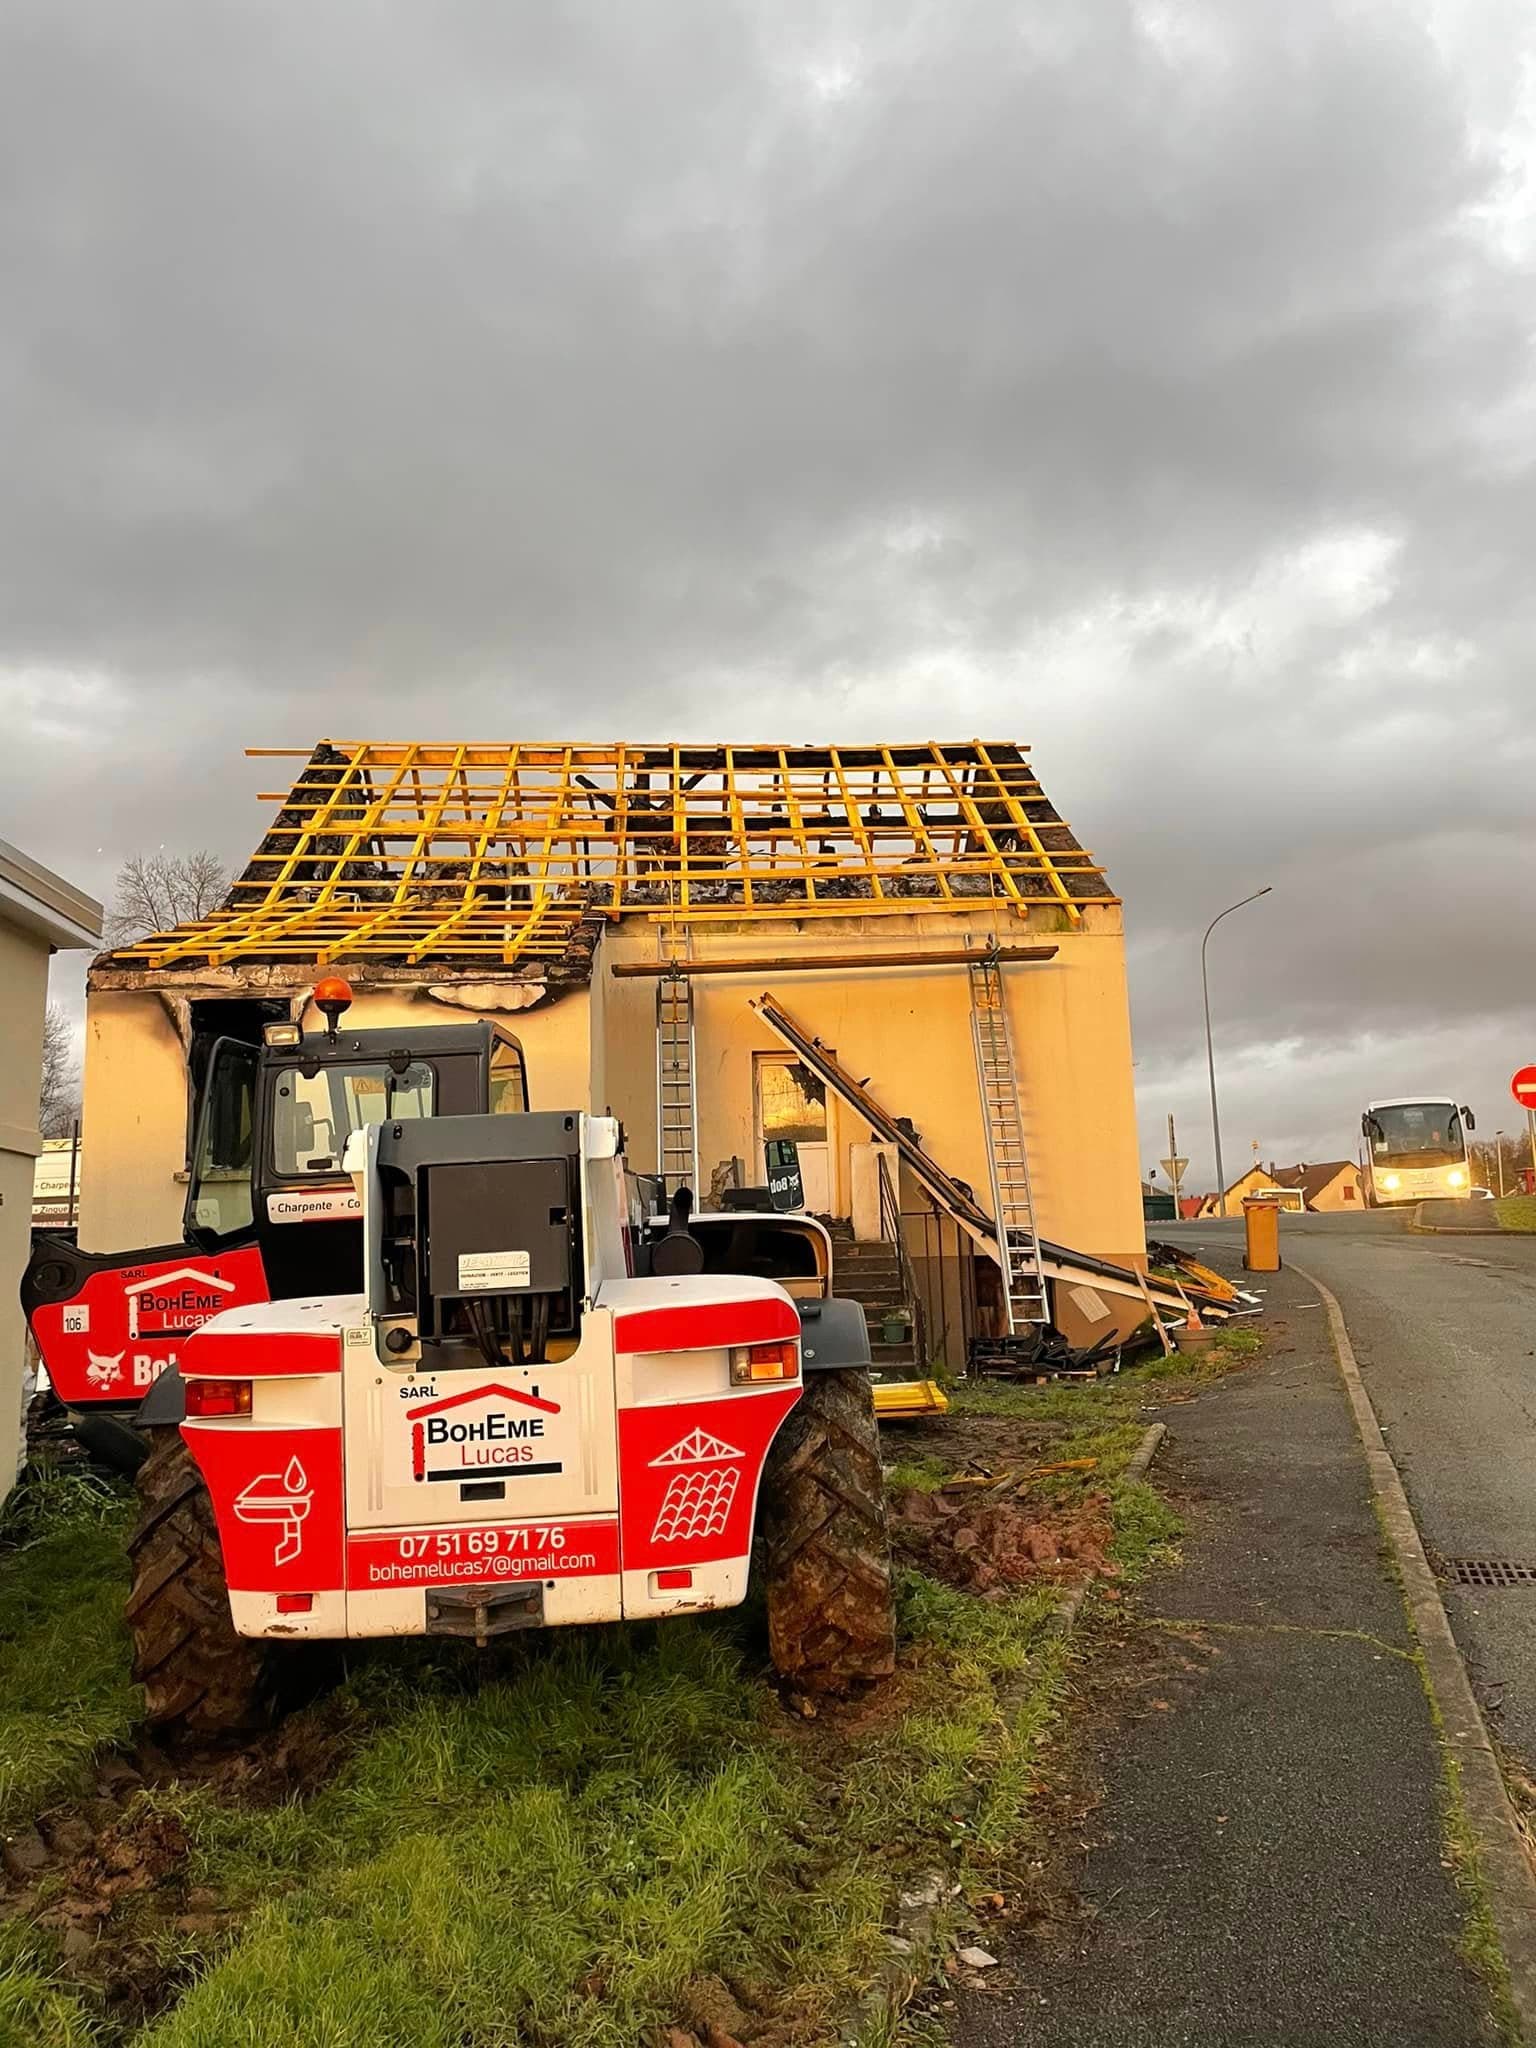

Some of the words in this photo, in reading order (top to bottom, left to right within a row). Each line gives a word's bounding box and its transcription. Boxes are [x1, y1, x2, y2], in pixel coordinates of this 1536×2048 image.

[277, 1201, 333, 1213] Charpente
[120, 1269, 148, 1279] SARL
[65, 1317, 82, 1331] 106
[399, 1386, 439, 1399] SARL
[461, 1445, 534, 1466] Lucas
[400, 1535, 431, 1558] 07
[436, 1533, 461, 1556] 51
[467, 1531, 499, 1554] 69
[505, 1529, 529, 1551] 71
[534, 1527, 566, 1549] 76
[369, 1552, 596, 1582] bohemelucas7@gmail.com
